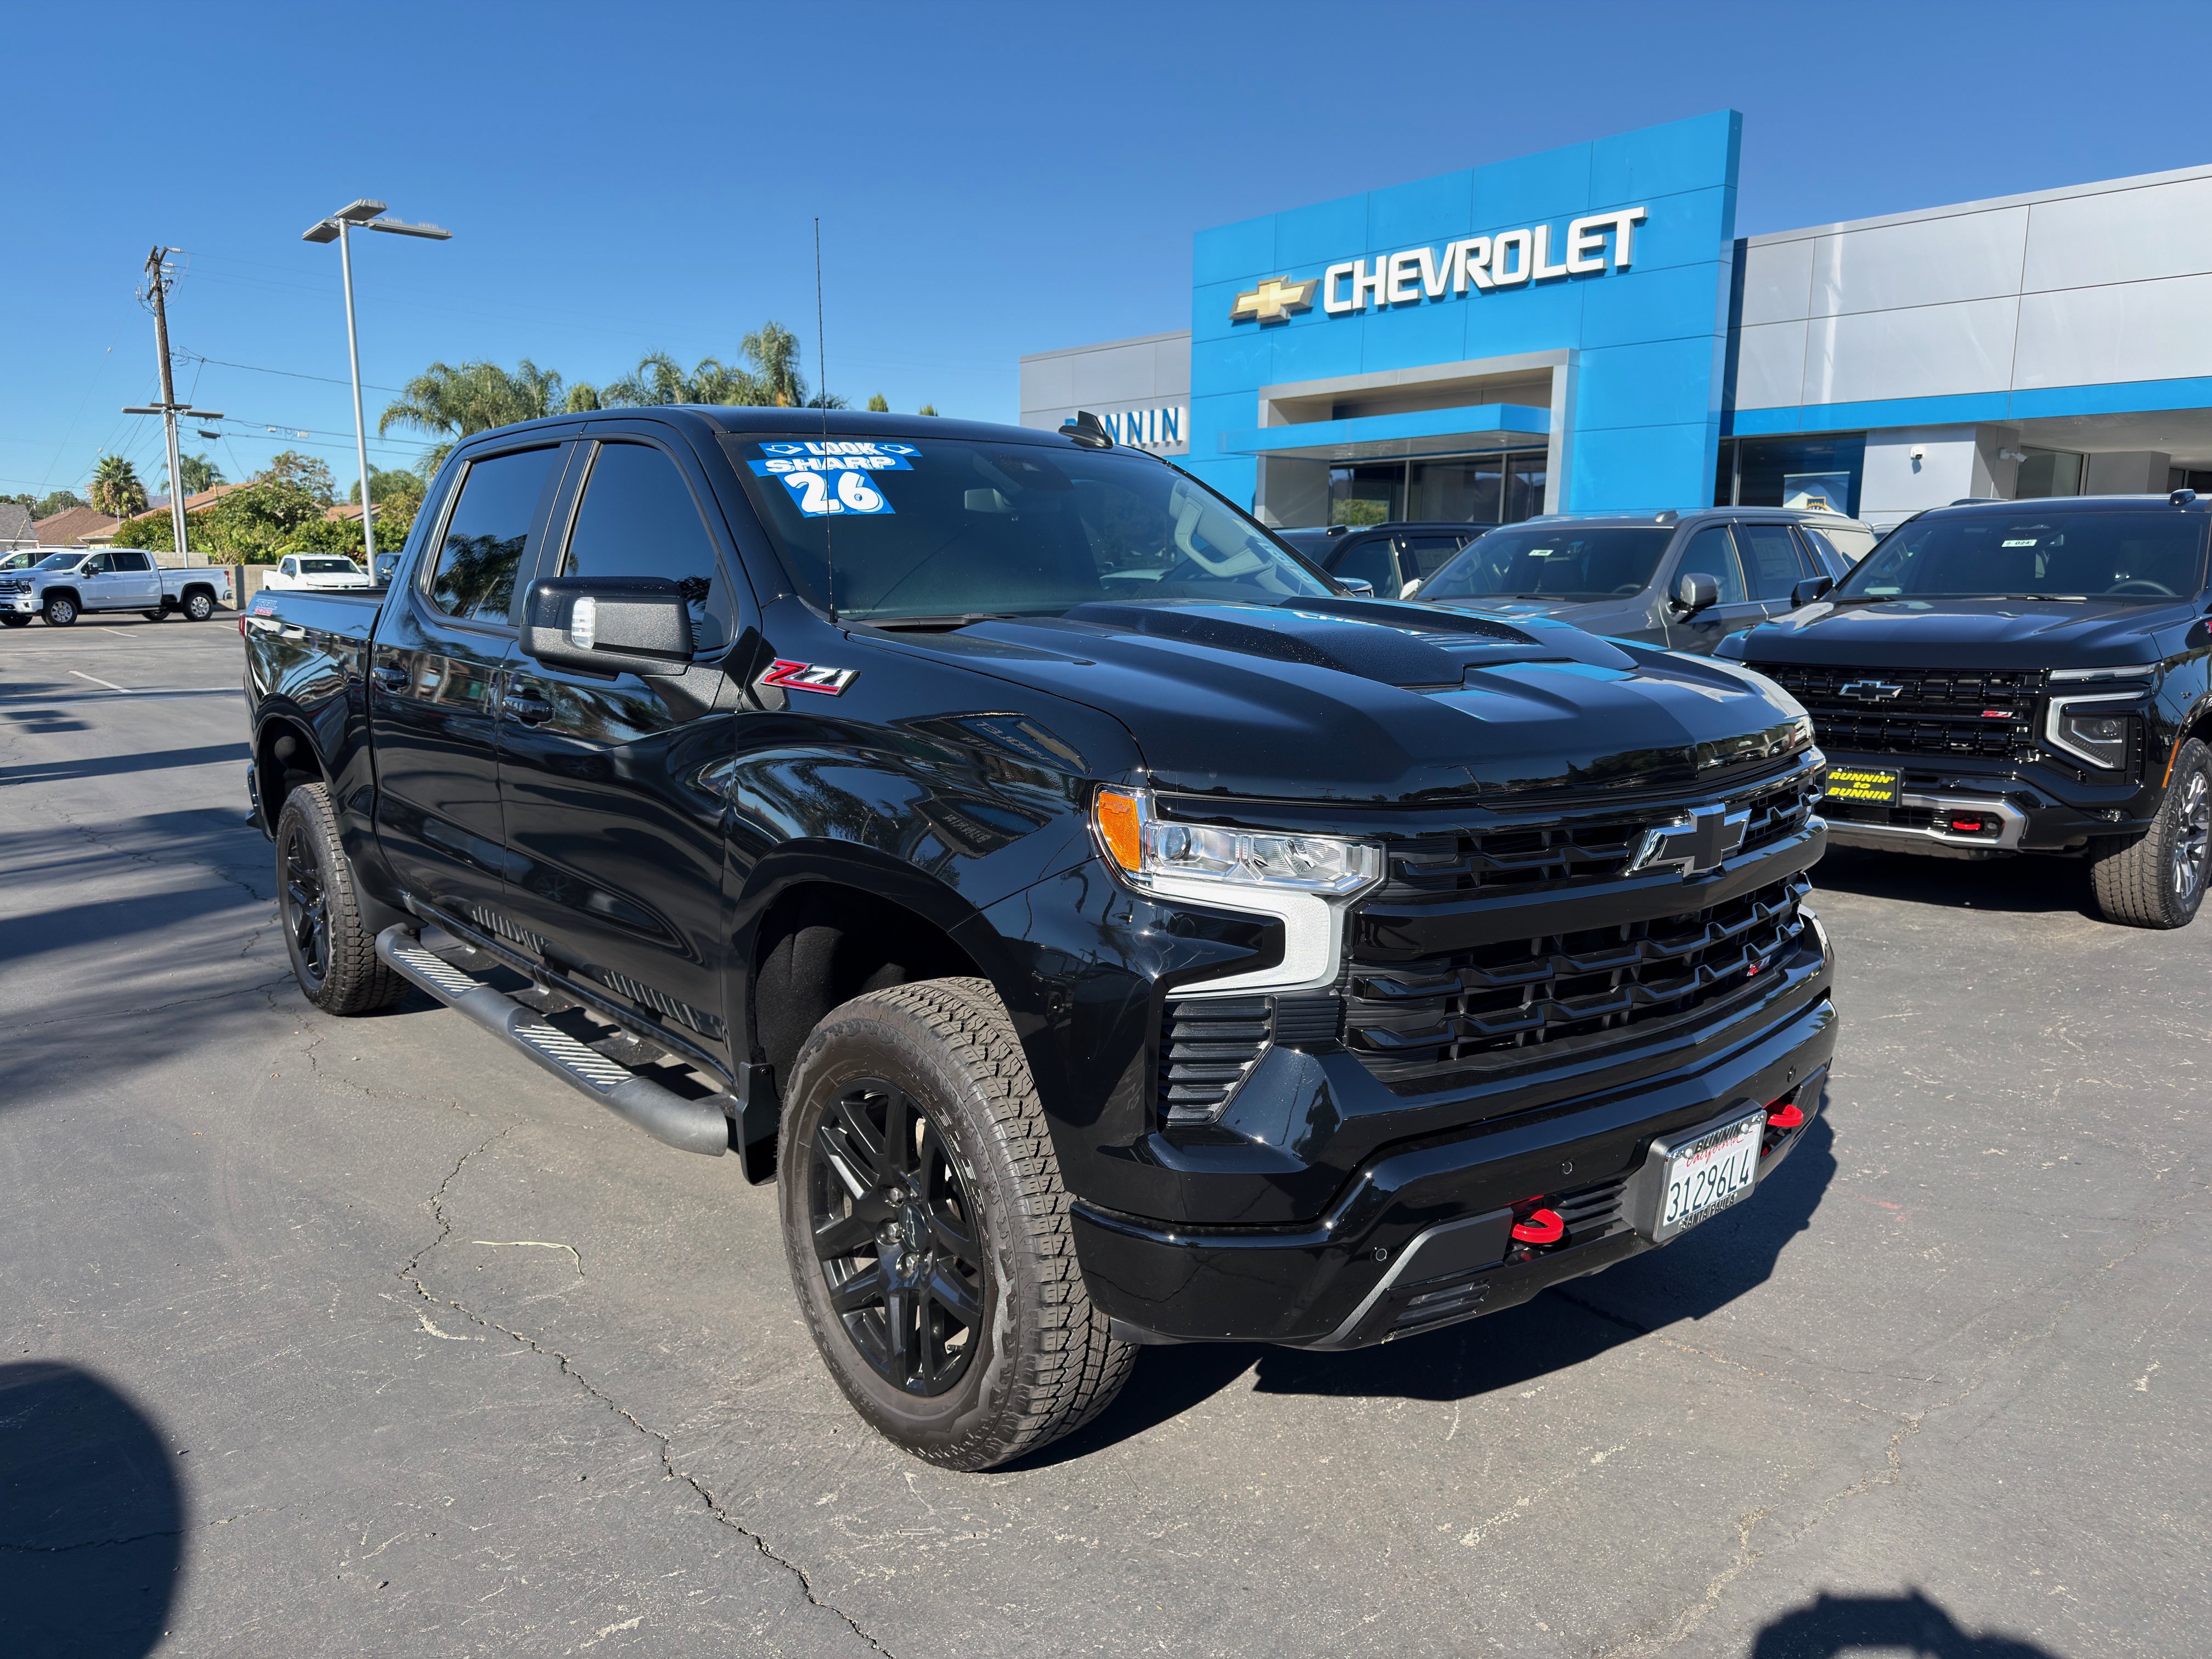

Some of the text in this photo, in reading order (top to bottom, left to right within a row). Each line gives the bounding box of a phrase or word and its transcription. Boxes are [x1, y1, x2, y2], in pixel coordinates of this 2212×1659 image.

[1323, 206, 1647, 314] CHEVROLET
[1064, 407, 1185, 447] NNIN
[765, 456, 896, 472] SHARP
[804, 442, 884, 455] LOOK
[784, 471, 884, 514] 26
[760, 658, 861, 697] Z71
[1827, 787, 1892, 800] BUNNIN
[1828, 772, 1895, 783] RUNNIN'
[1694, 1121, 1743, 1154] BUNNIN
[1667, 1149, 1749, 1222] 31296L4
